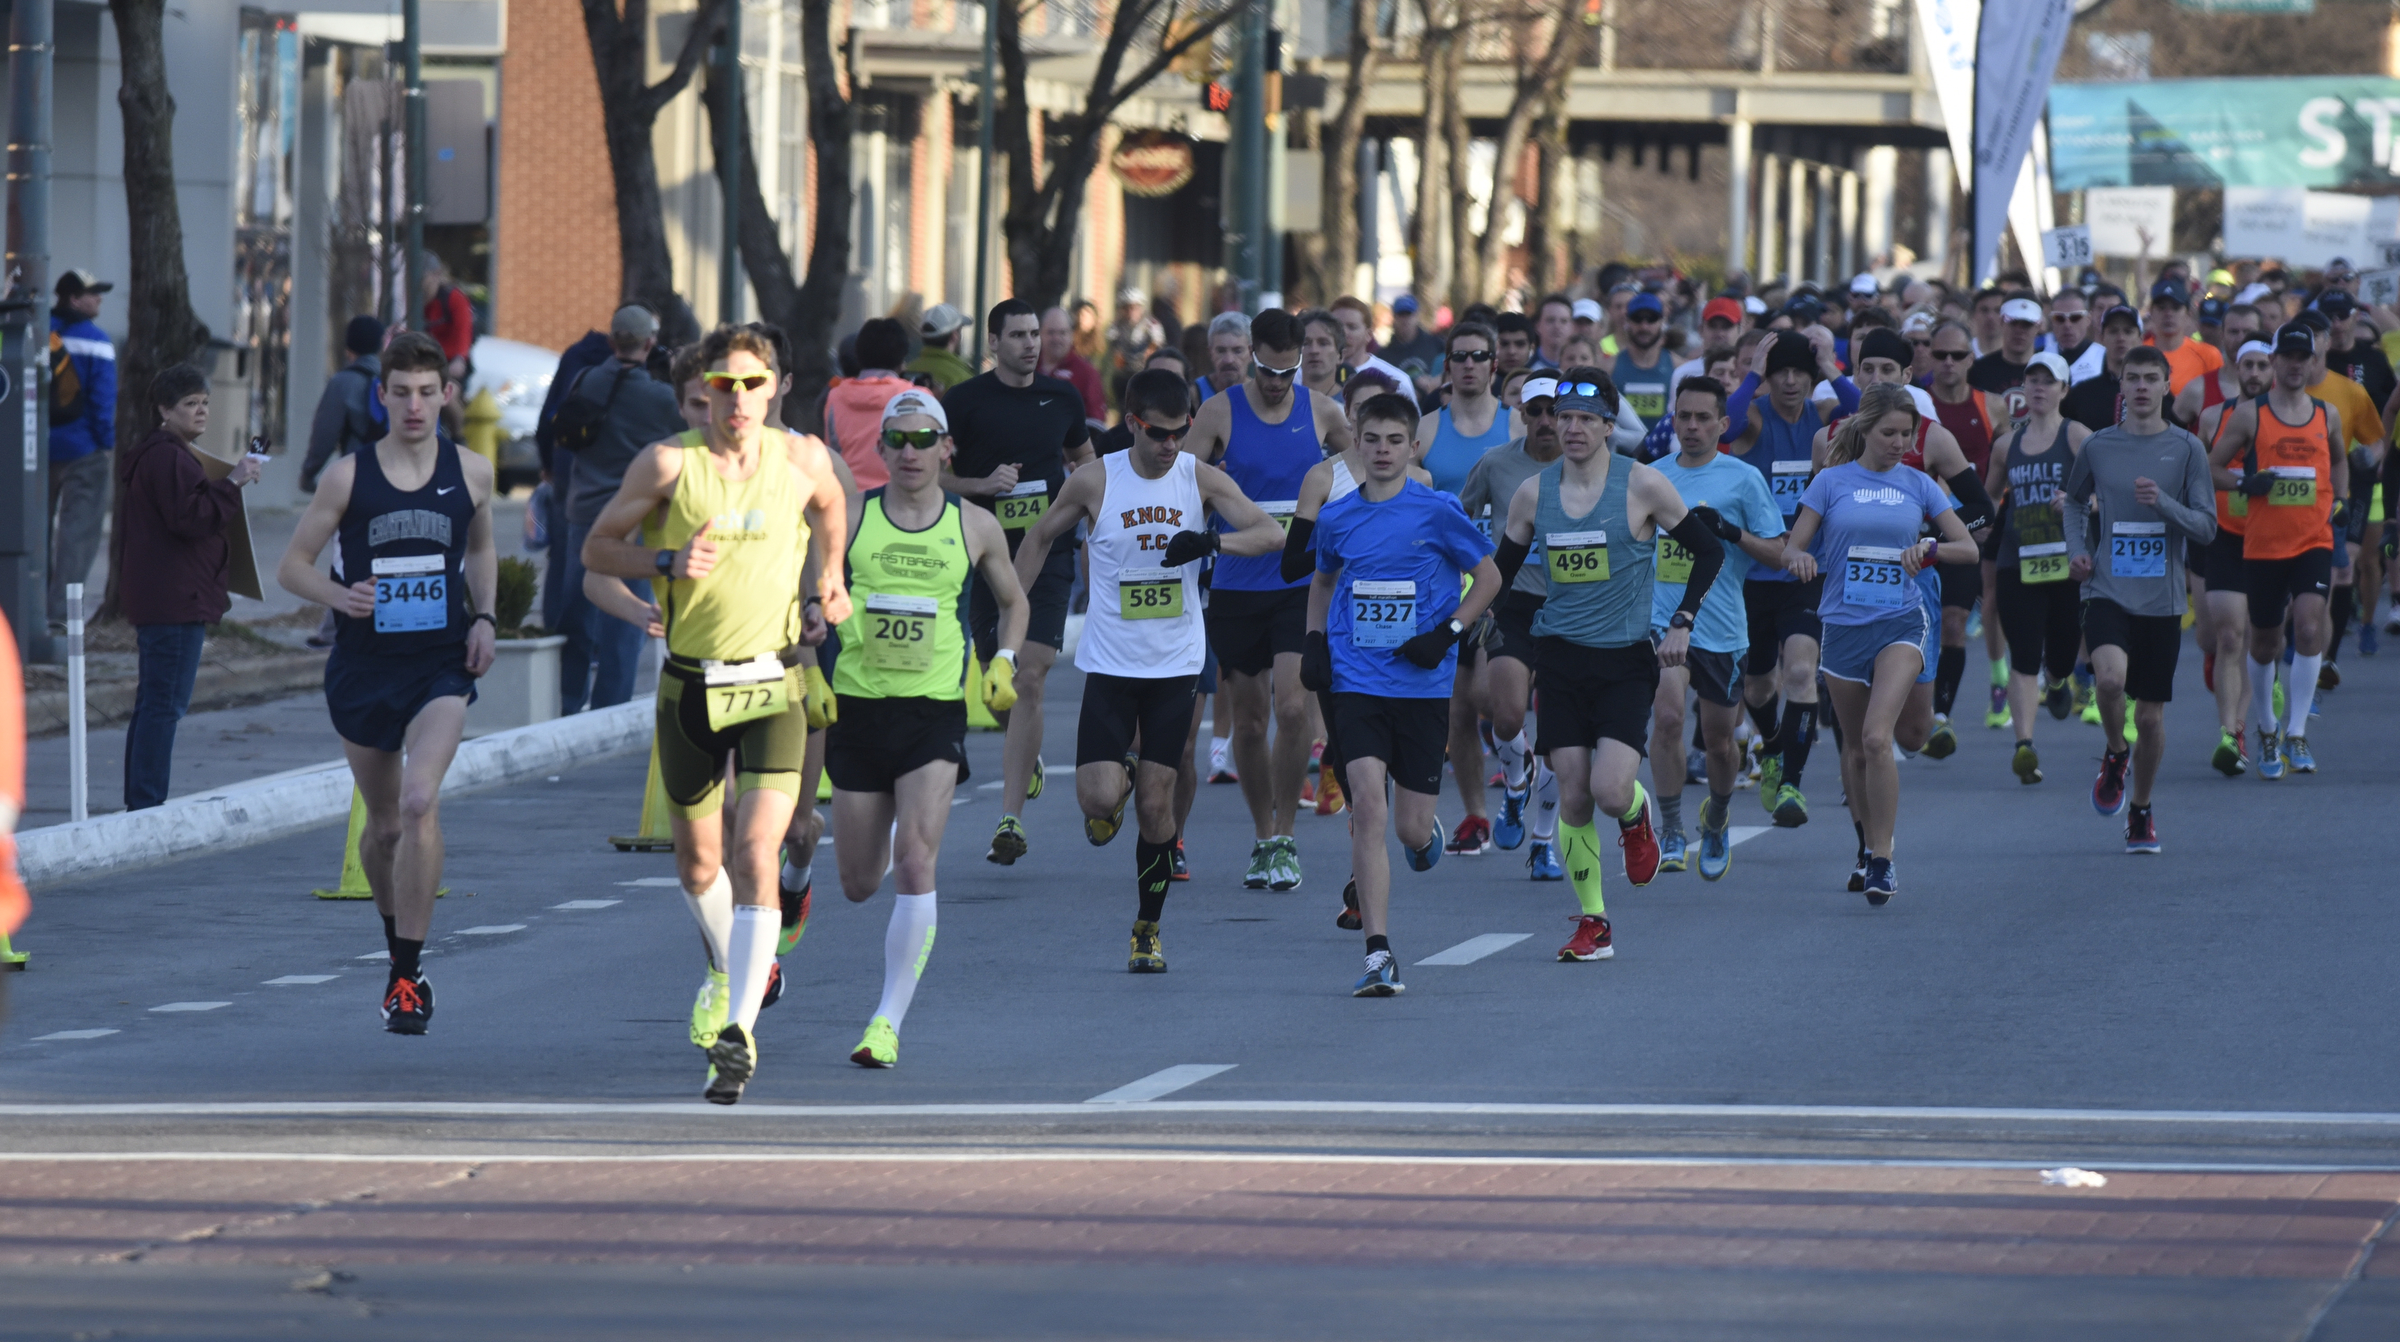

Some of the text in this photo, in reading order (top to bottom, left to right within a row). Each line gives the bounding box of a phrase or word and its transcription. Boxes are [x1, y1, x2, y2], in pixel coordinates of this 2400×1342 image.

[2009, 462, 2063, 486] INHALE
[2013, 482, 2061, 507] BLACK
[2276, 481, 2310, 497] 309
[1004, 499, 1041, 519] 824
[1121, 506, 1183, 529] KNOX
[1662, 542, 1695, 562] 346
[2115, 540, 2164, 556] 2199
[1556, 551, 1599, 571] 496
[2029, 558, 2062, 575] 285
[1848, 564, 1902, 585] 3253
[378, 579, 443, 604] 3446
[1130, 587, 1172, 608] 585
[1356, 602, 1413, 622] 2327
[875, 618, 924, 641] 205
[721, 689, 774, 713] 772
